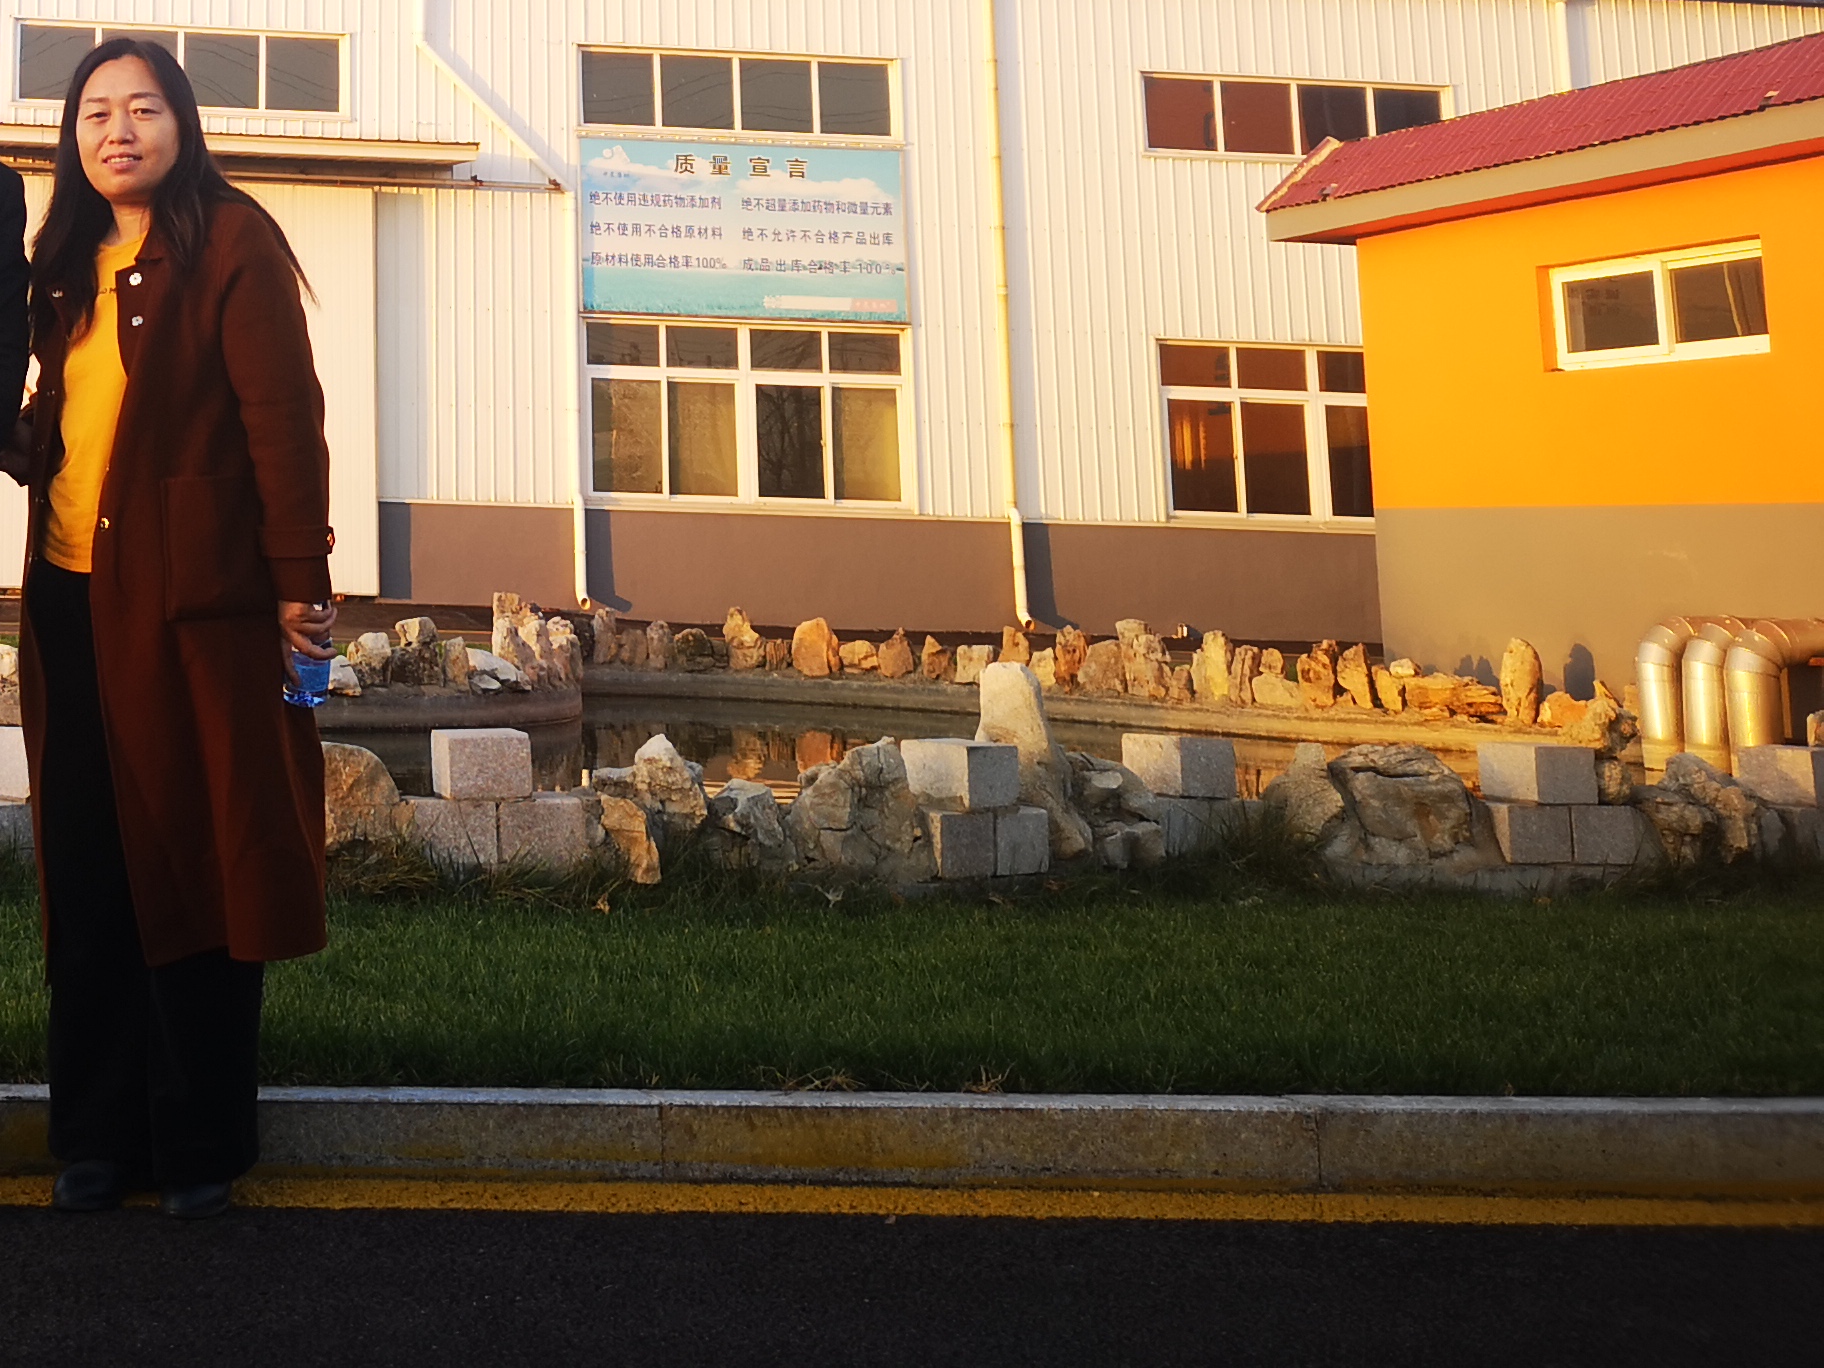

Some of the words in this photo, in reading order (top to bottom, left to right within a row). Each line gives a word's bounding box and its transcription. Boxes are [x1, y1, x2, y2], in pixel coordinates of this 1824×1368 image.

[674, 153, 808, 179] 质量宣言
[588, 190, 722, 210] 绝不使用违规药物添加剂
[741, 197, 893, 217] 绝不超量添加药物和微量元素
[589, 220, 723, 240] 绝不使用不合格原材料
[742, 226, 894, 246] 绝不允许不合格产品出库
